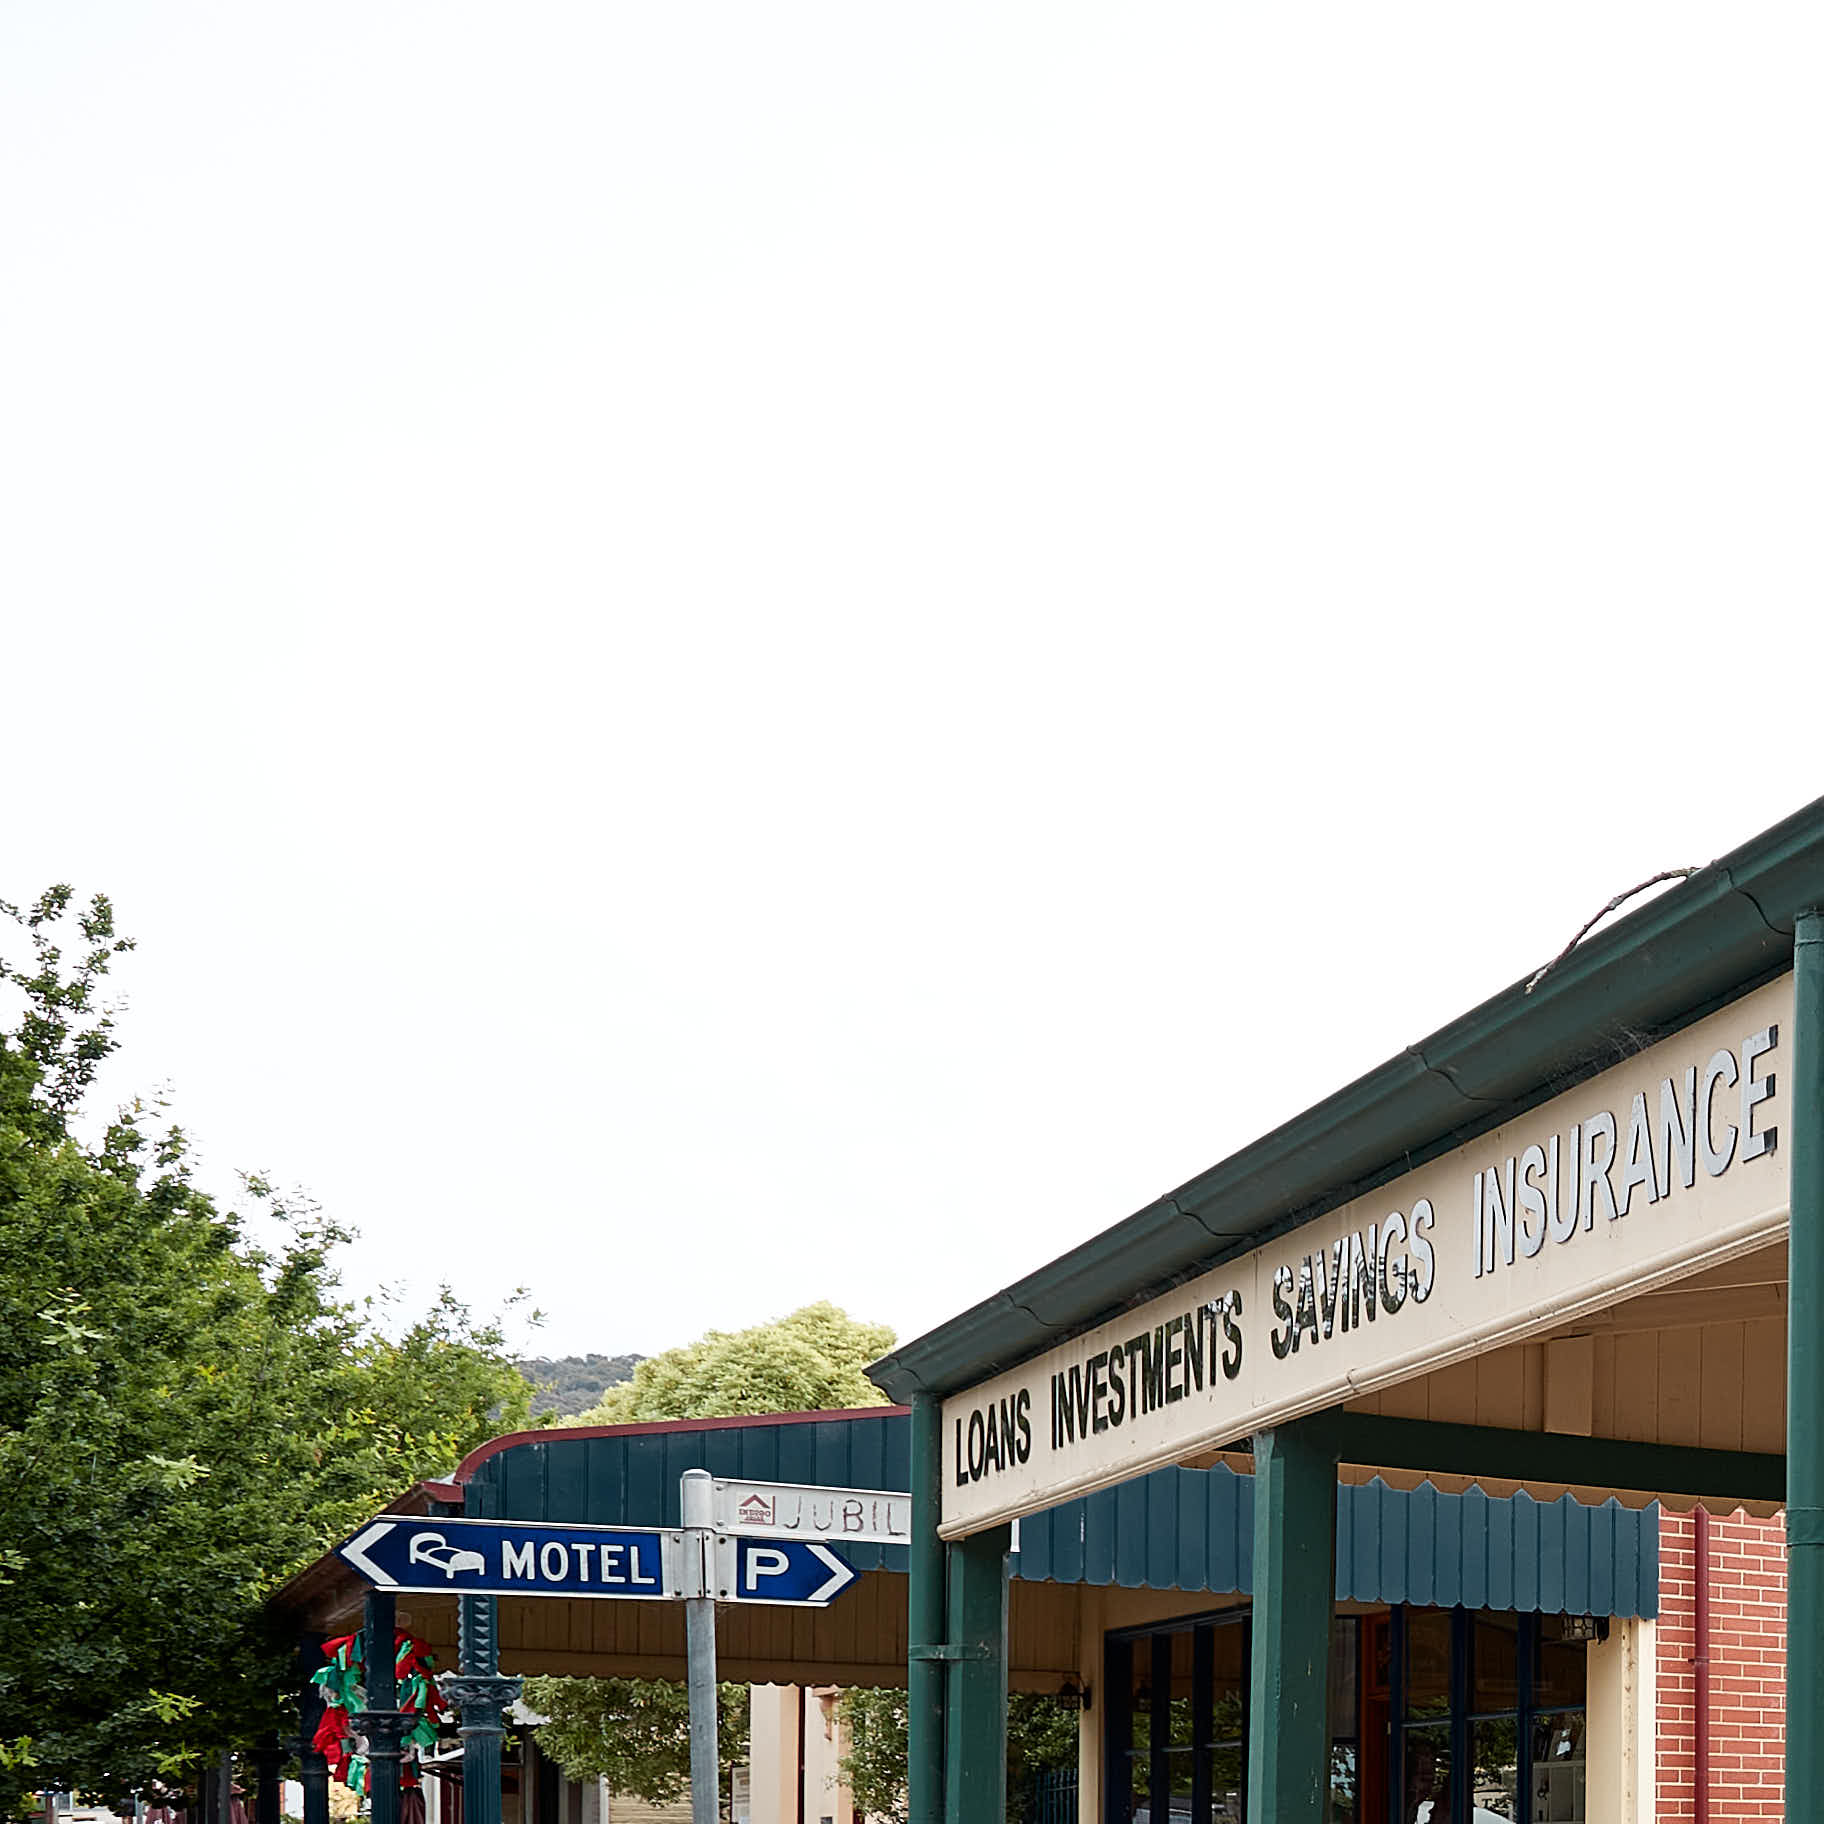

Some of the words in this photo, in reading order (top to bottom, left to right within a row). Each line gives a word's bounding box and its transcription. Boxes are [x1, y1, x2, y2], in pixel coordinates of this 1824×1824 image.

[956, 1388, 1031, 1487] LOANS
[1051, 1289, 1242, 1450] INVESTMENTS
[1270, 1199, 1435, 1360] SAVINGS
[1473, 1024, 1778, 1279] INSURANCE
[502, 1540, 655, 1584] MOTEL
[745, 1548, 789, 1590] P
